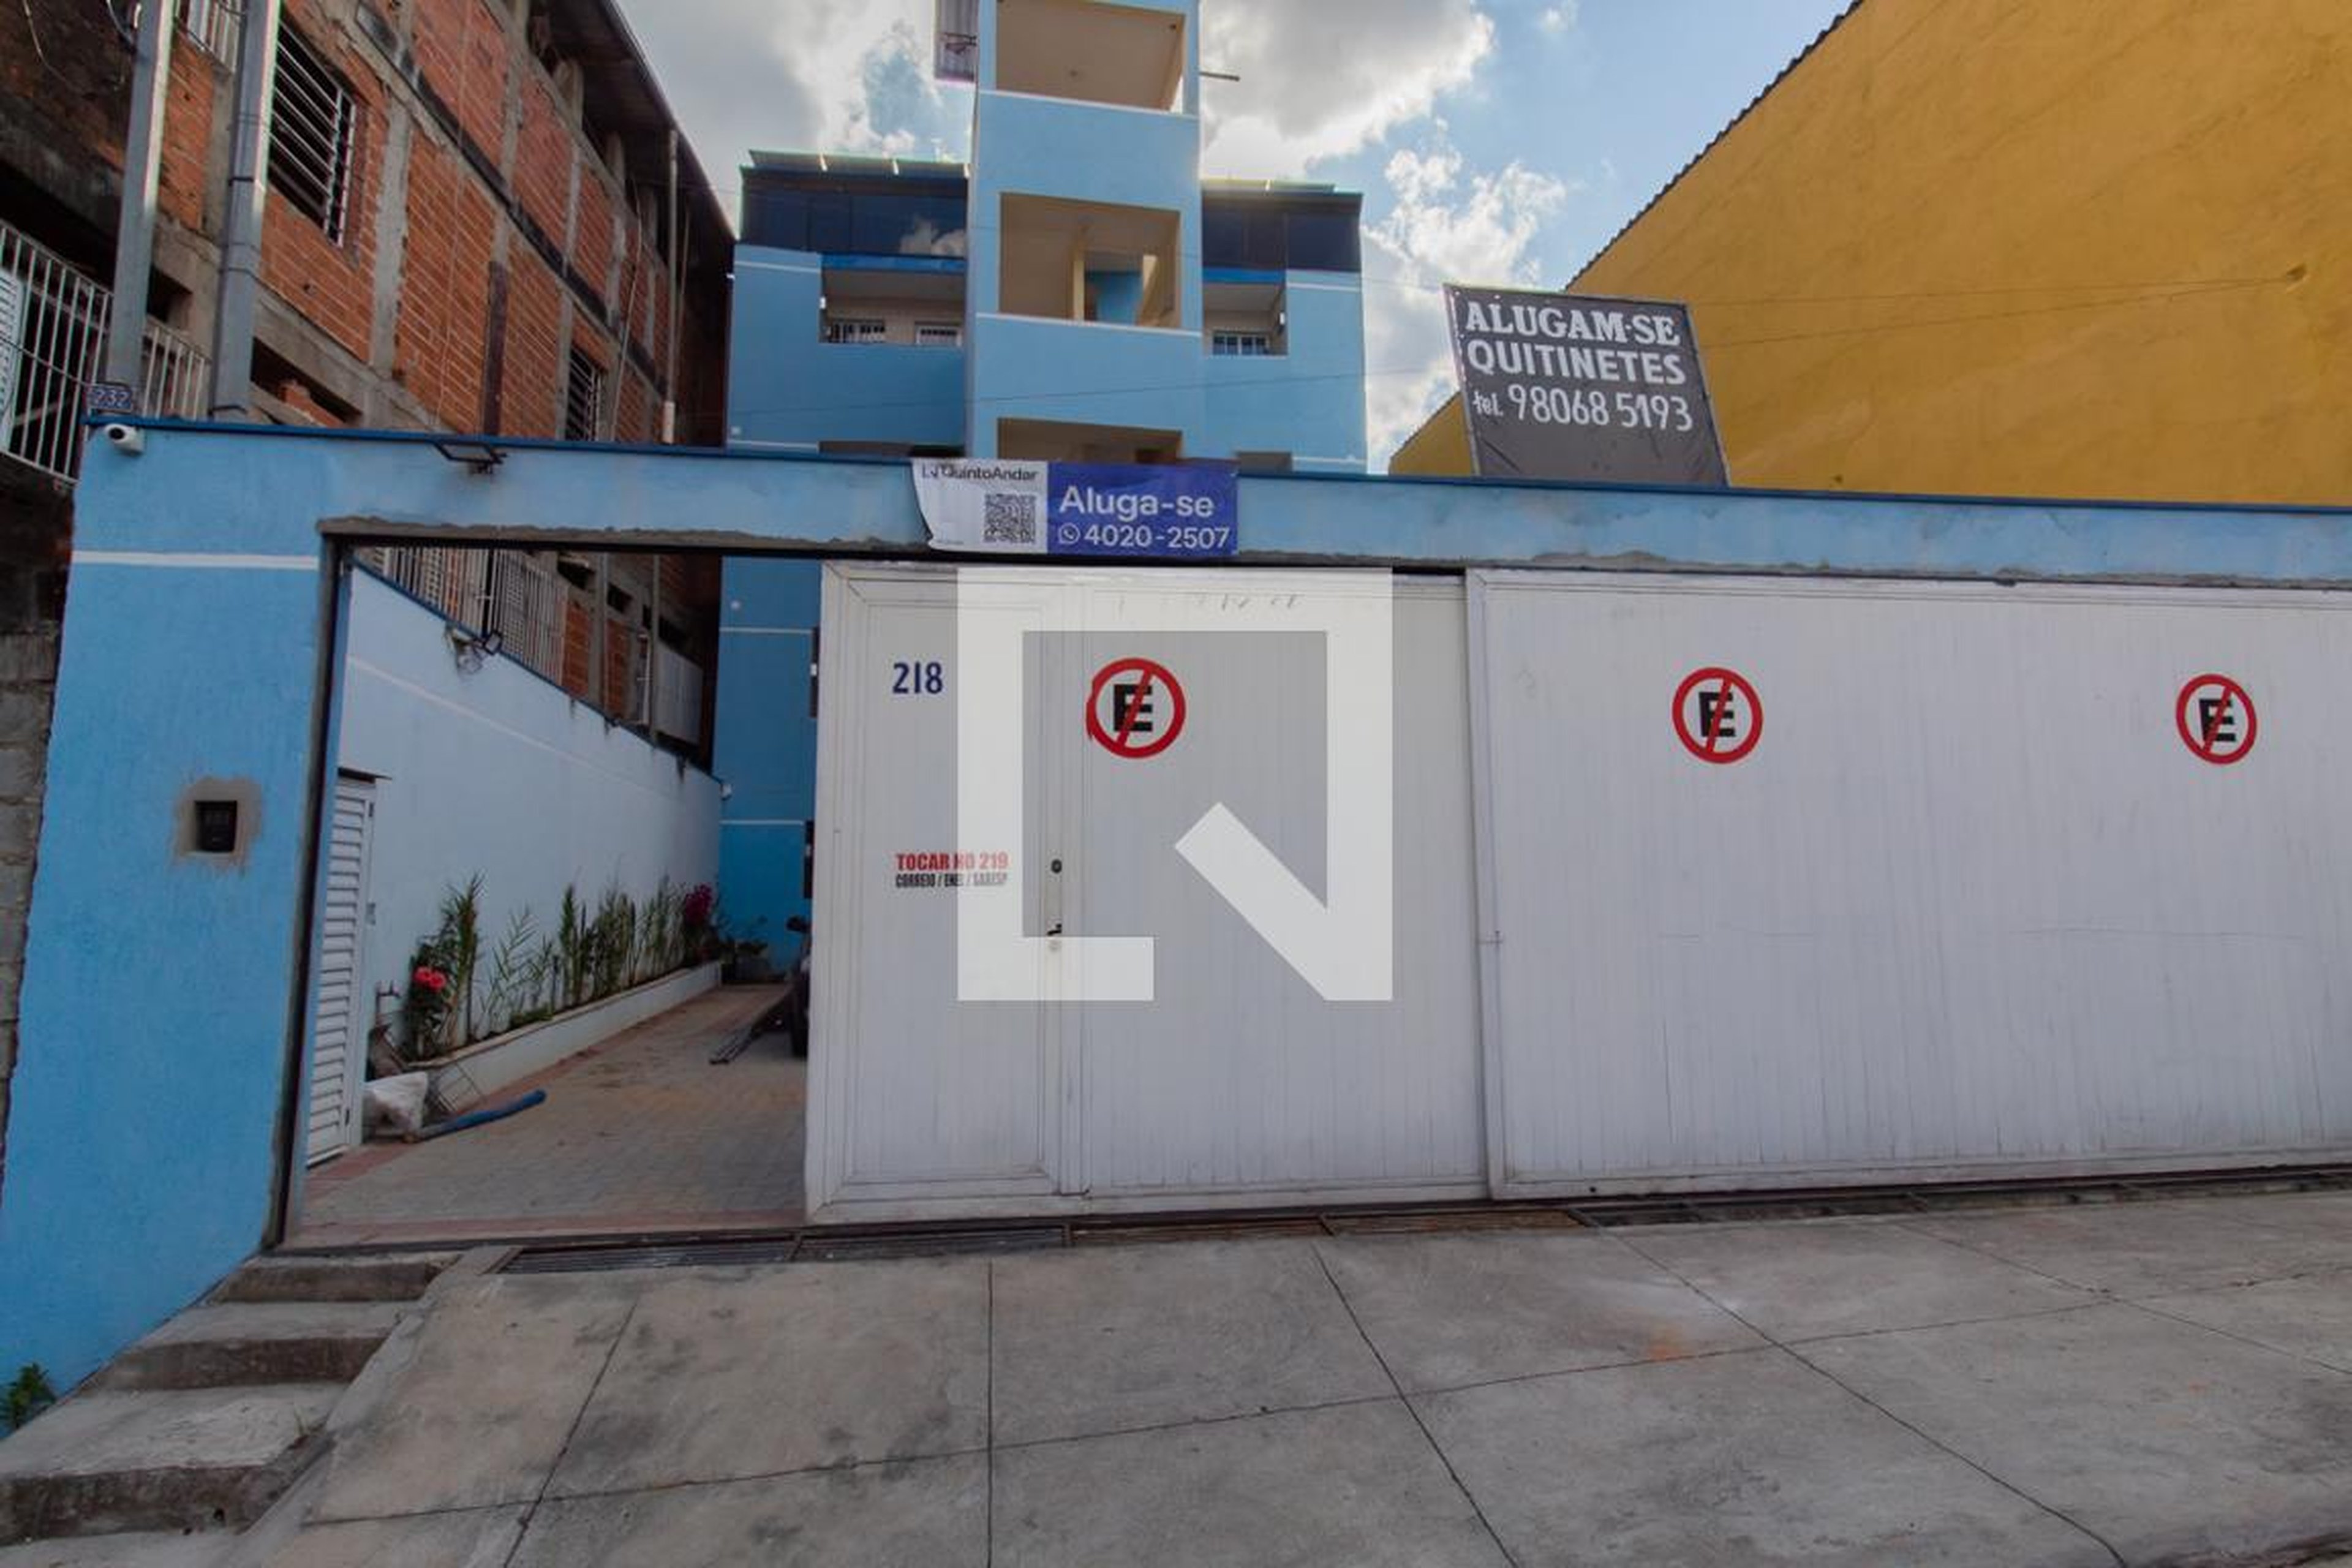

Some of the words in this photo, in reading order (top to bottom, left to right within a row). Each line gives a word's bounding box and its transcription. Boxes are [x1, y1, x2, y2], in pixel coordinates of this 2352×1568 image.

[1466, 301, 1681, 347] ALUGAM-SE
[1467, 339, 1686, 385] QUITINETES
[1507, 383, 1609, 426] 98068
[1615, 393, 1694, 432] 5193
[1059, 486, 1214, 522] Aluga-se
[1084, 524, 1230, 549] 4020-2507
[892, 662, 944, 694] 218
[895, 853, 949, 870] TOCAR
[980, 852, 1008, 869] 219
